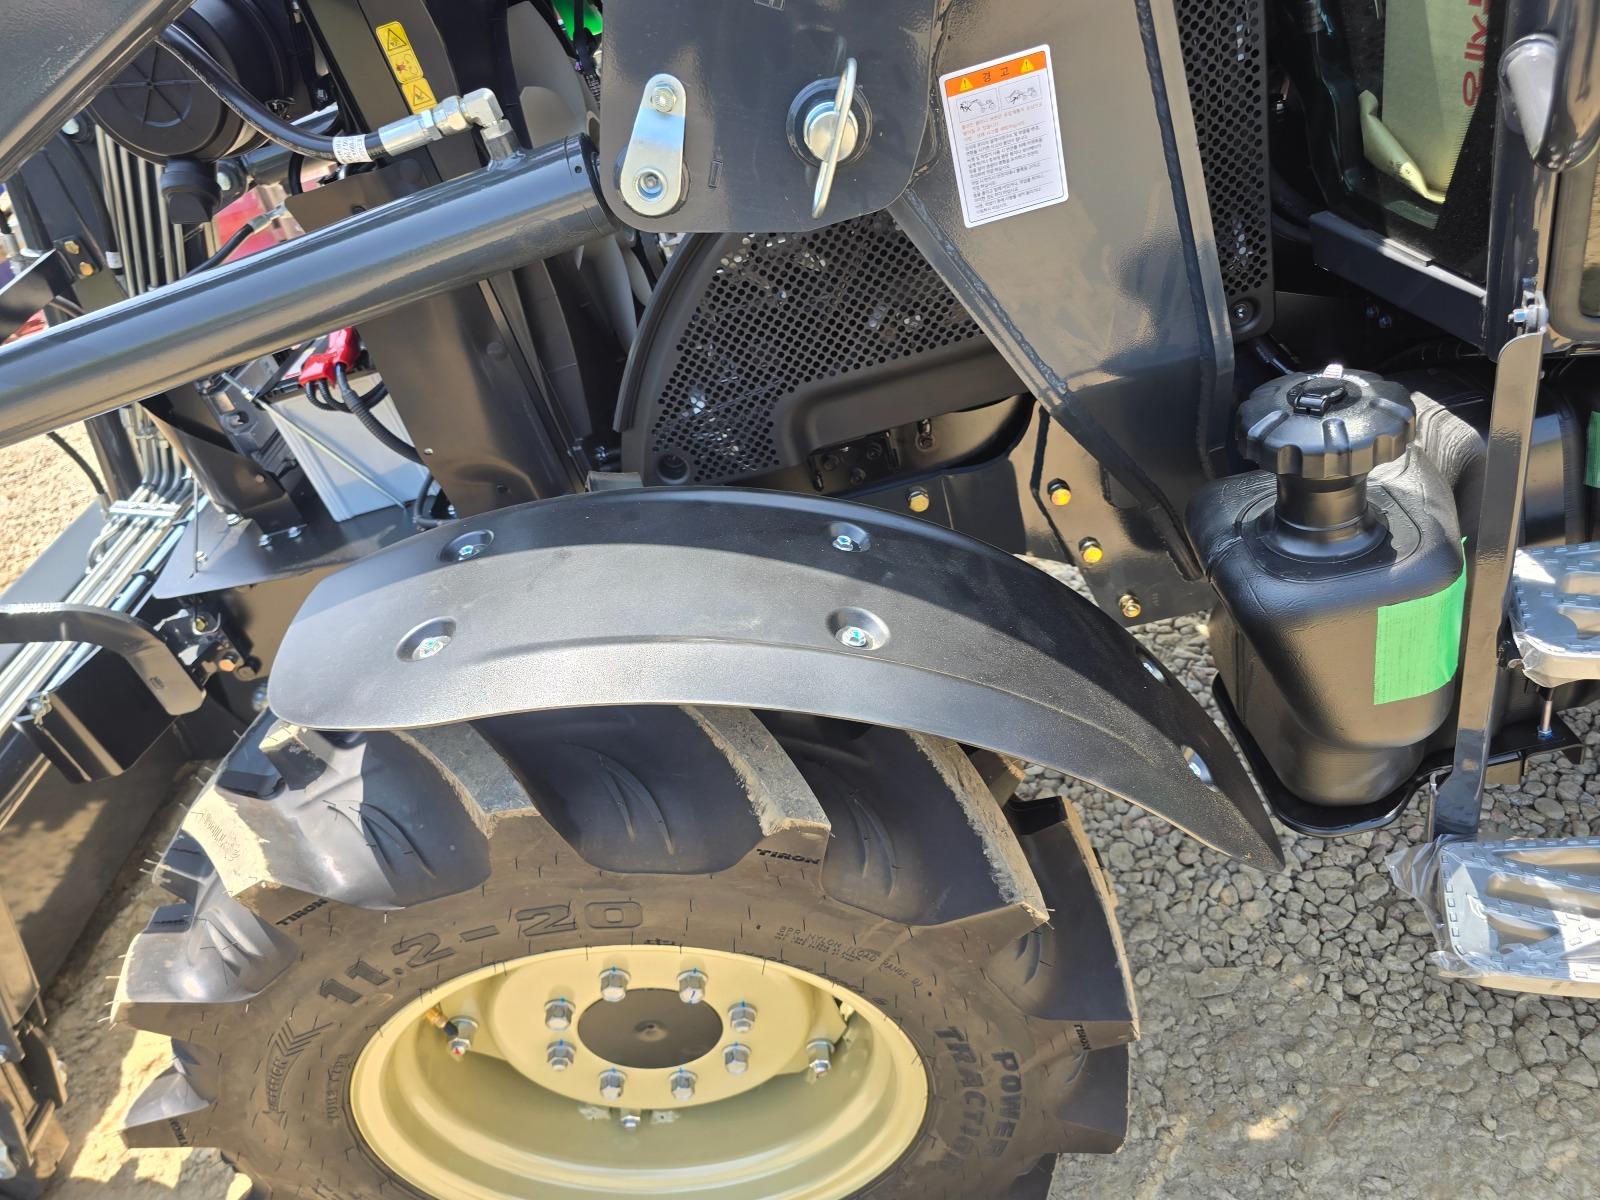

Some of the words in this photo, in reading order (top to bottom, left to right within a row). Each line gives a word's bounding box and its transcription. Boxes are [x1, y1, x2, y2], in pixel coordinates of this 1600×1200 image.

[756, 848, 821, 865] TIRON
[276, 898, 328, 926] TIRON
[808, 933, 842, 949] NYLON
[1074, 1023, 1092, 1051] TIRON
[989, 1051, 1022, 1157] POWER
